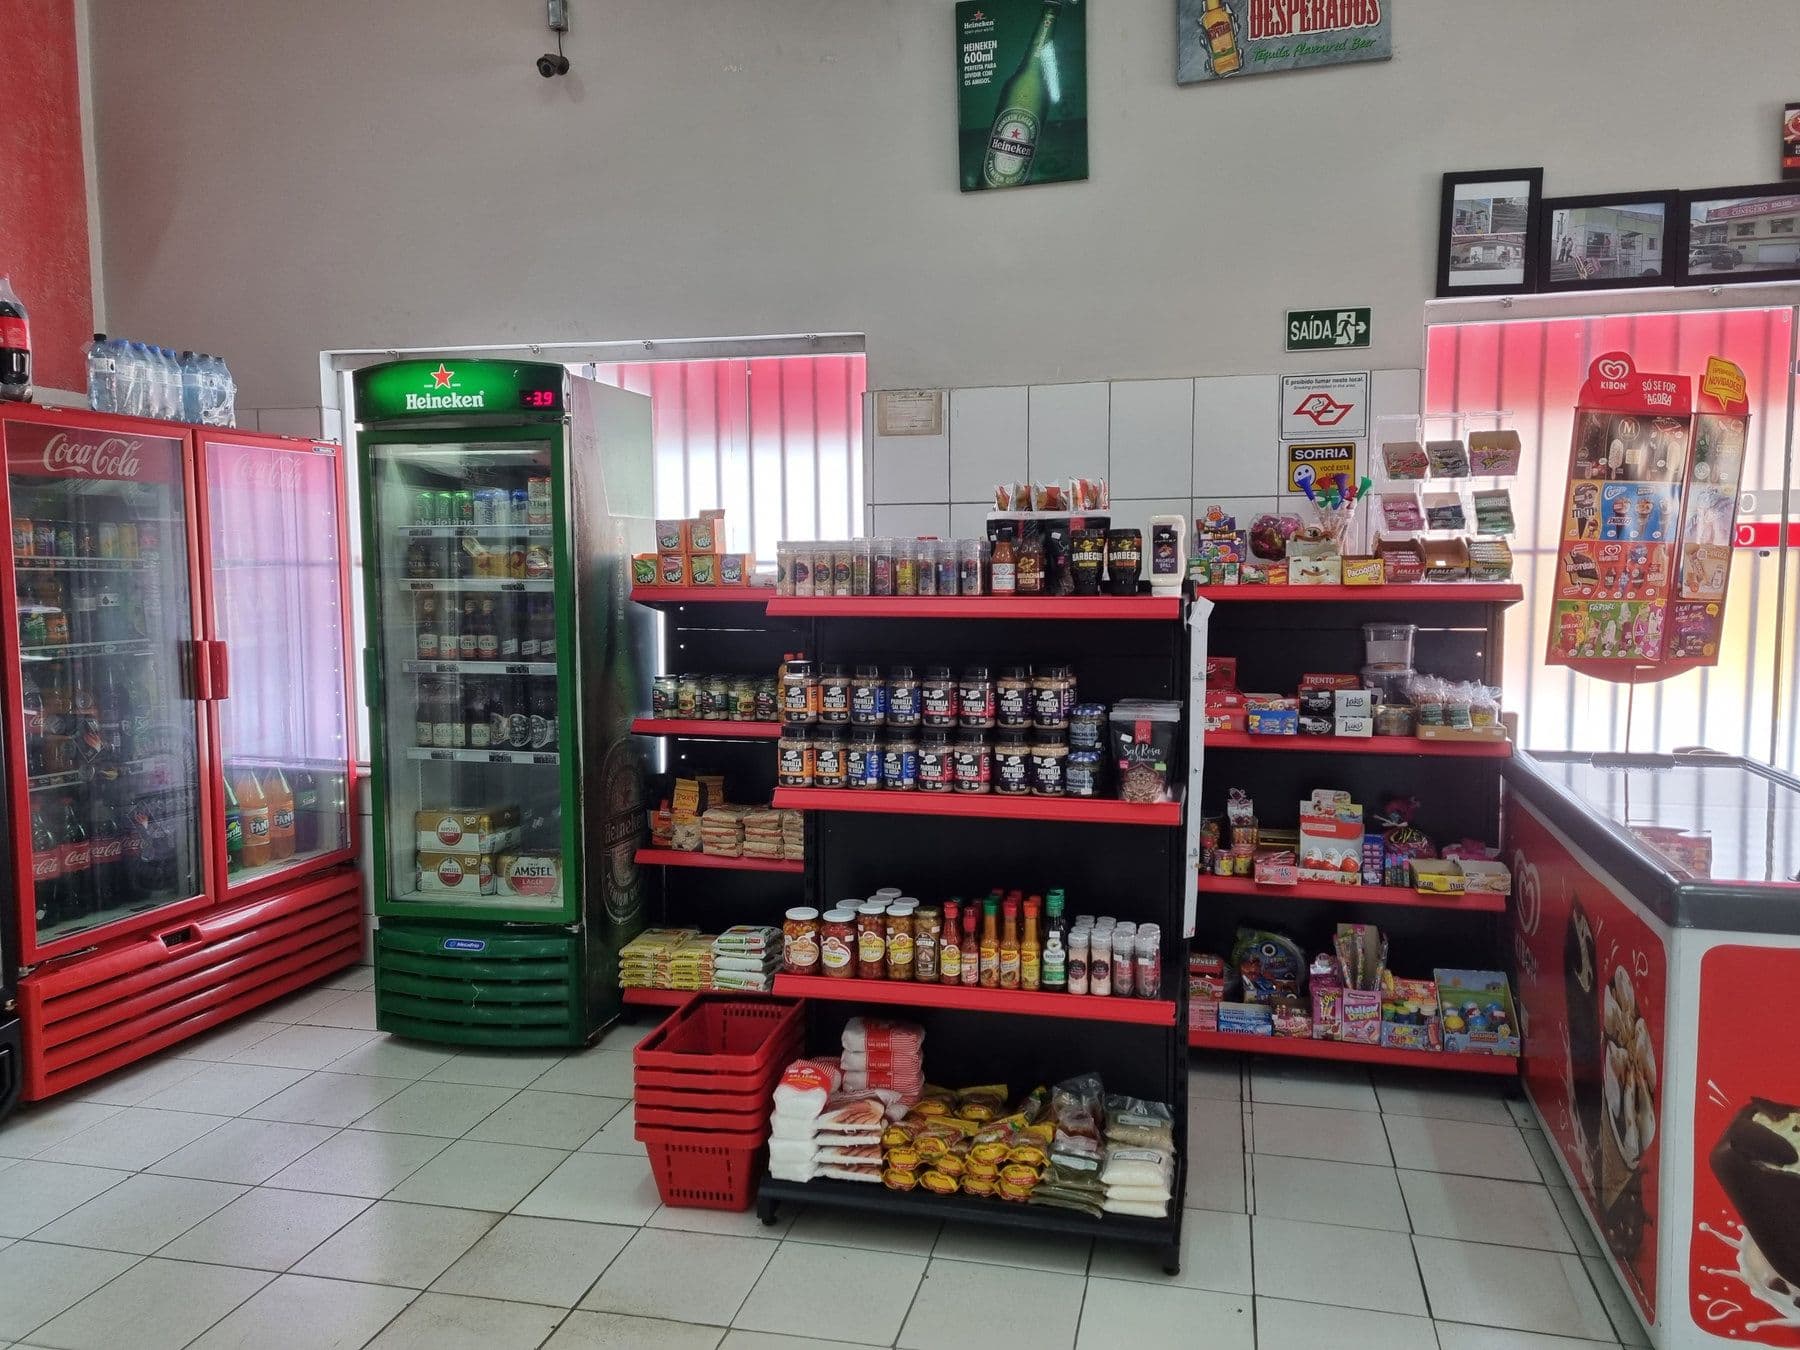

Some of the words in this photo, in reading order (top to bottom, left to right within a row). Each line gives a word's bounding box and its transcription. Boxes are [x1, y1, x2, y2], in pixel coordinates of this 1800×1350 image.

[963, 20, 995, 29] Heineken
[963, 40, 998, 53] HEINEKEN
[1253, 46, 1290, 63] Tequila
[1351, 38, 1377, 51] Beer
[964, 49, 993, 64] 600ml
[984, 62, 997, 70] PARA
[992, 138, 1031, 156] Heineken
[1291, 315, 1332, 341] SAÍDA
[1291, 379, 1313, 387] proibido
[1600, 382, 1627, 390] KIBON
[1642, 378, 1652, 391] SÓ
[1653, 380, 1661, 390] SE
[1663, 381, 1677, 393] FOR
[406, 391, 485, 410] Heineken
[1647, 393, 1672, 406] AGORA
[43, 433, 144, 477] Coca-Cola
[1295, 448, 1348, 460] SORRIA
[1305, 676, 1335, 685] TRENTO
[1122, 744, 1140, 757] Sal
[1141, 744, 1161, 757] Rosa
[514, 866, 550, 876] AMSTEL
